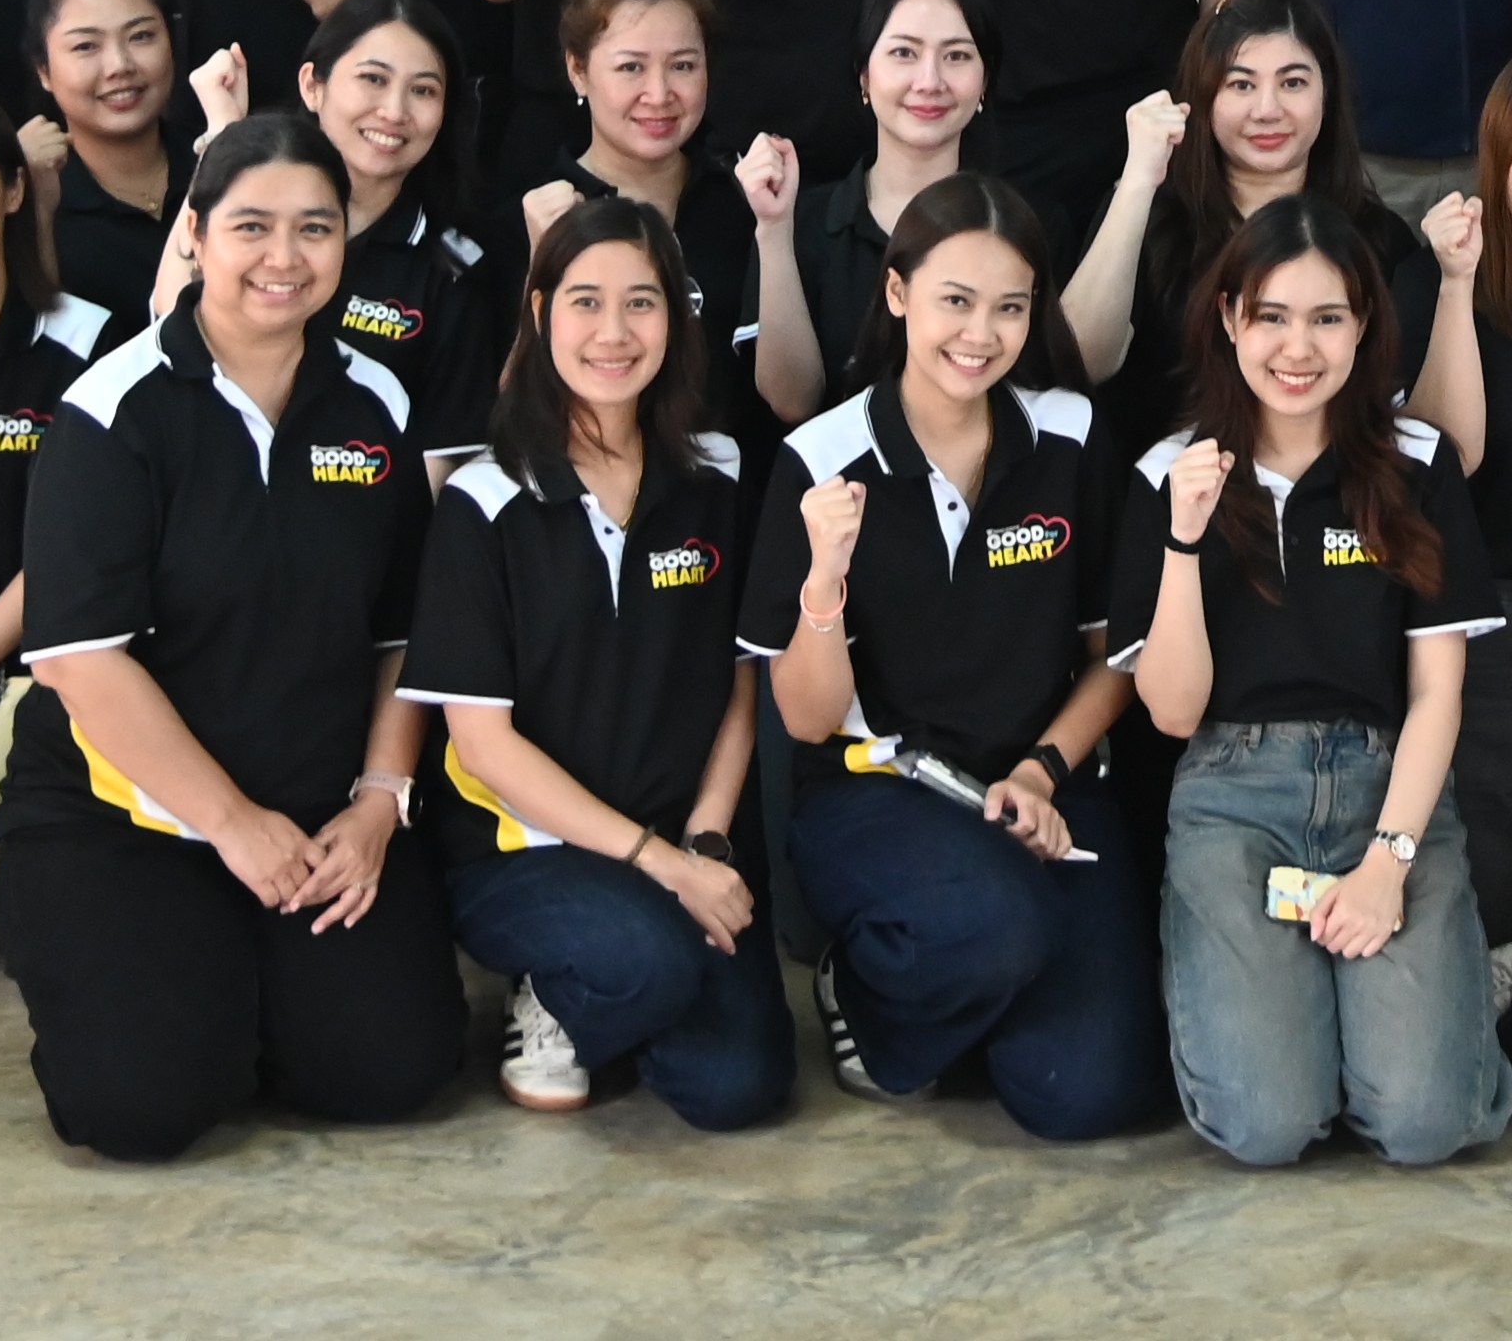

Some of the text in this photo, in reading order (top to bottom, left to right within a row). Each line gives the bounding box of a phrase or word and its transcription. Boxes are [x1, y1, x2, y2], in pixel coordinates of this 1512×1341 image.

[346, 297, 402, 325] GOOD
[341, 310, 407, 340] HEART
[310, 449, 367, 468] GOOD
[311, 464, 377, 485] HEART
[986, 524, 1046, 552] GOOD
[648, 548, 702, 574] GOOD
[988, 538, 1056, 569] HEART
[650, 563, 707, 590] HEART
